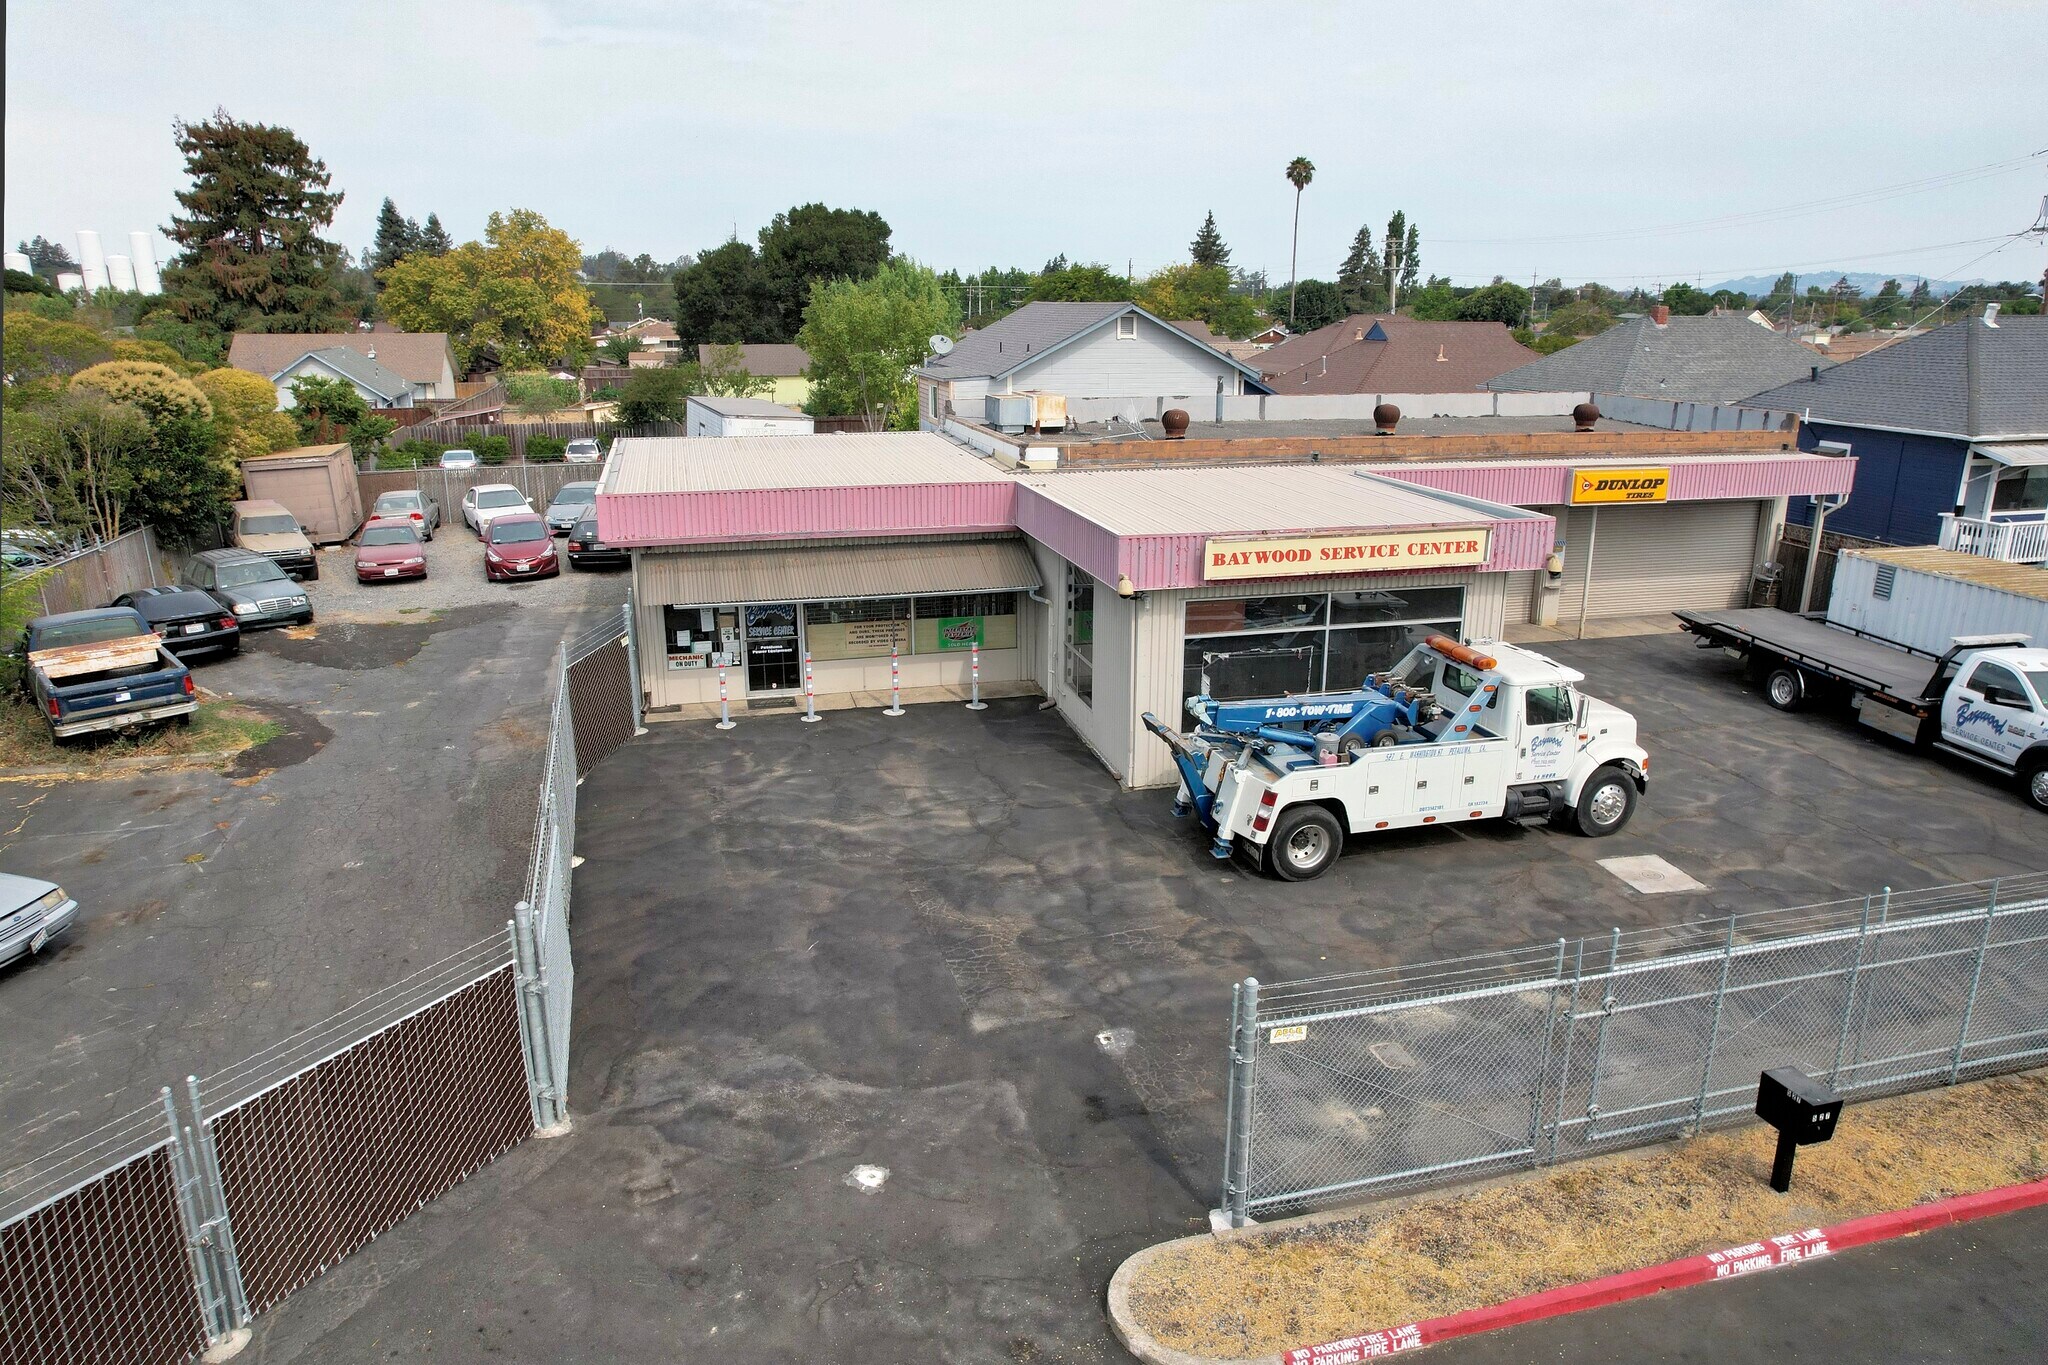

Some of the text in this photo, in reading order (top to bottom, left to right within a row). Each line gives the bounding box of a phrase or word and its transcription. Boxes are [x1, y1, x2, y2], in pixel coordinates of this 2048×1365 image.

[1595, 479, 1665, 491] DUNLOP
[1212, 540, 1479, 566] BAYWOOD SERVICE CENTER
[749, 625, 795, 637] SERVICE CENTER
[1956, 703, 2008, 736] Baywood
[1531, 736, 1564, 752] Baywood
[1951, 726, 2006, 753] SERVICE CENTER
[1707, 1228, 1826, 1263] NO PARKING FIRE LANE
[1717, 1241, 1831, 1277] NO PARKING FIRE LANE
[1292, 1324, 1421, 1361] NO PARKING FIRE LANE
[1313, 1349, 1359, 1365] PARKING
[1364, 1342, 1389, 1358] FIRE
[1393, 1334, 1423, 1351] LANE
